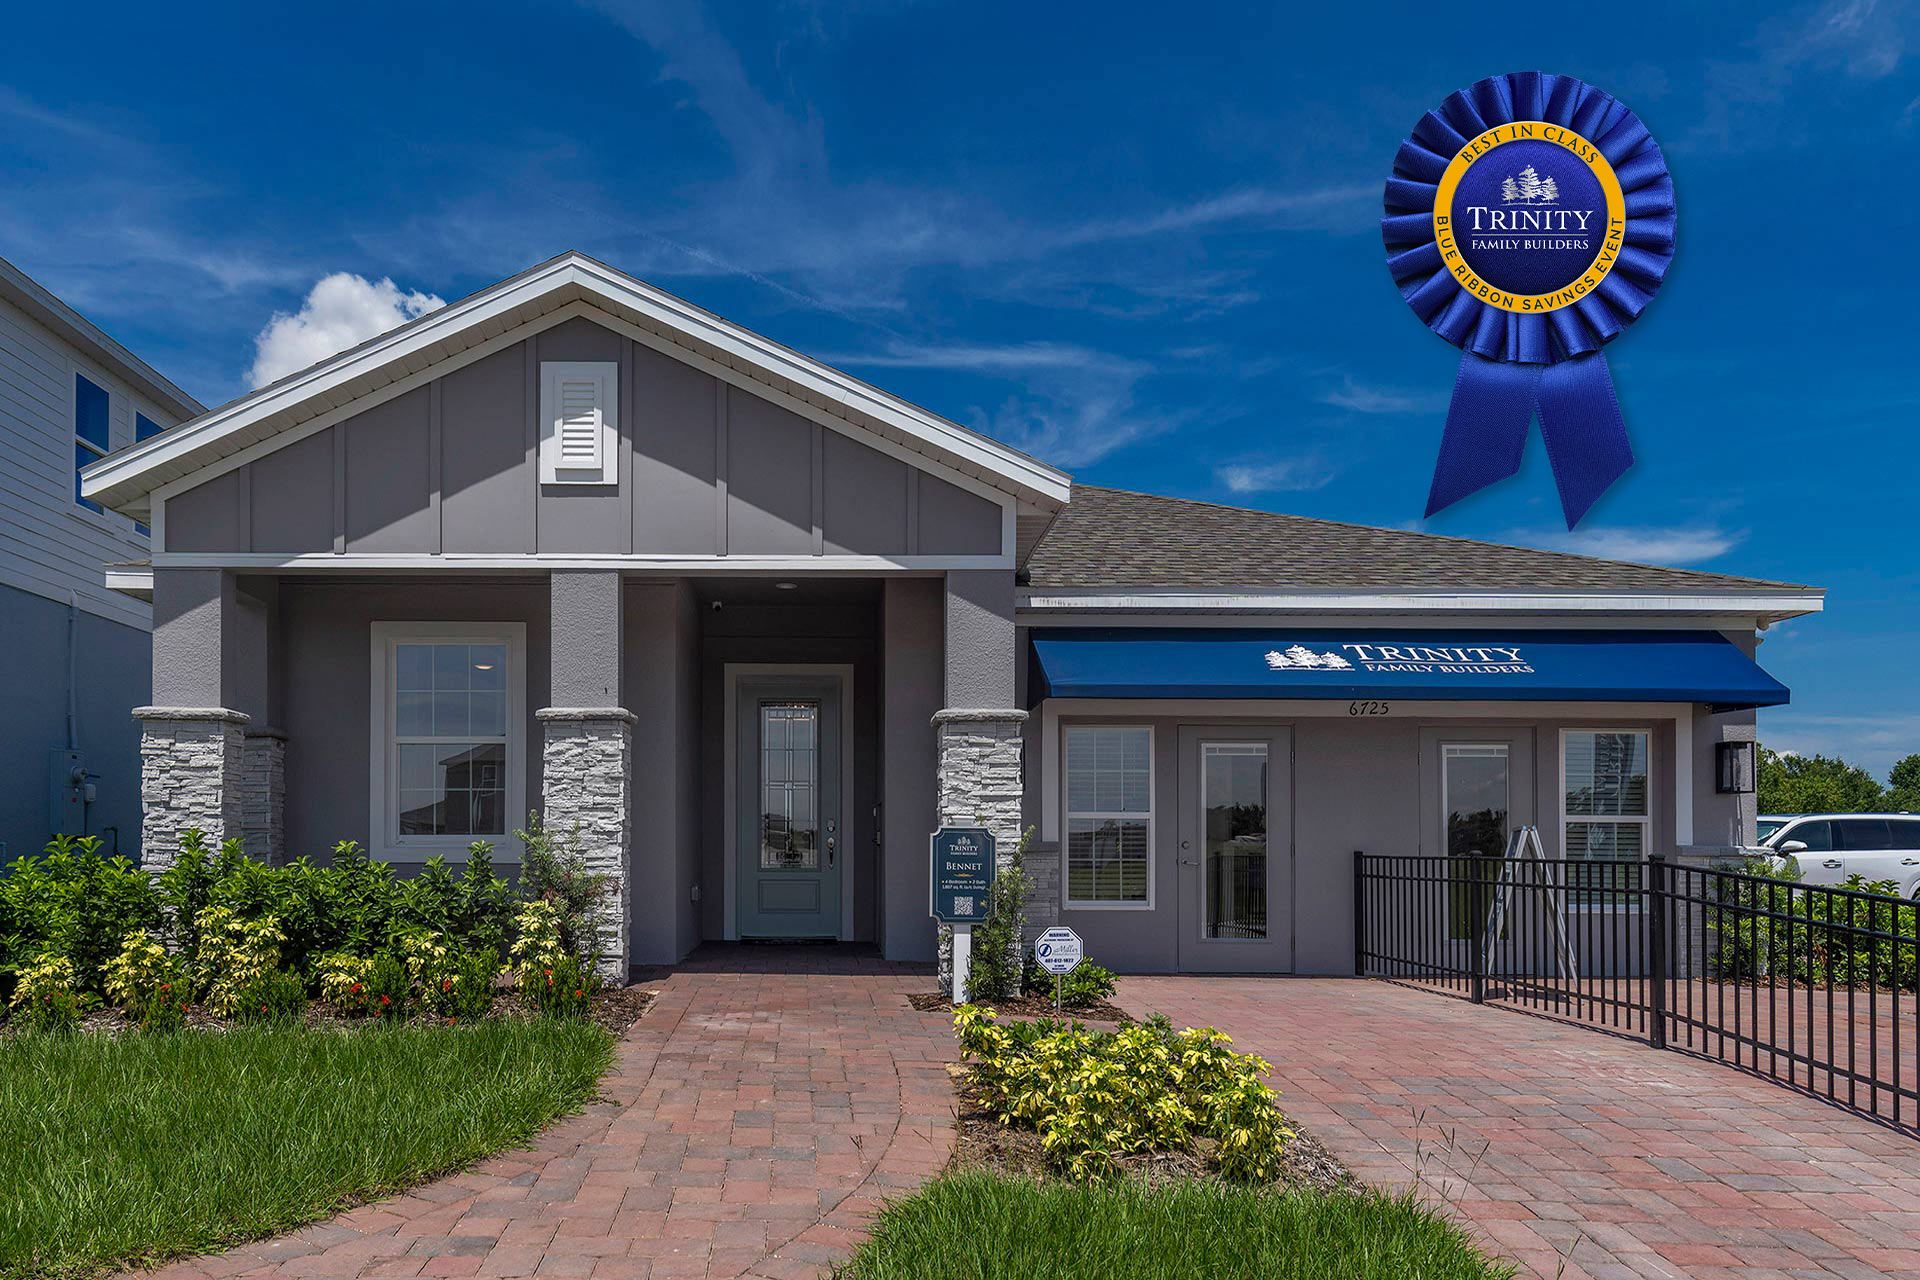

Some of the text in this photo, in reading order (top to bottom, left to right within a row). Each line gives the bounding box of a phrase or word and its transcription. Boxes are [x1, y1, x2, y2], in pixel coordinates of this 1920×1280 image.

[1343, 644, 1525, 662] TRINITY
[1366, 664, 1535, 674] FAMILY BUILDERS
[1349, 701, 1389, 716] 6725
[949, 844, 979, 852] TRINITY
[946, 861, 983, 871] BENNET
